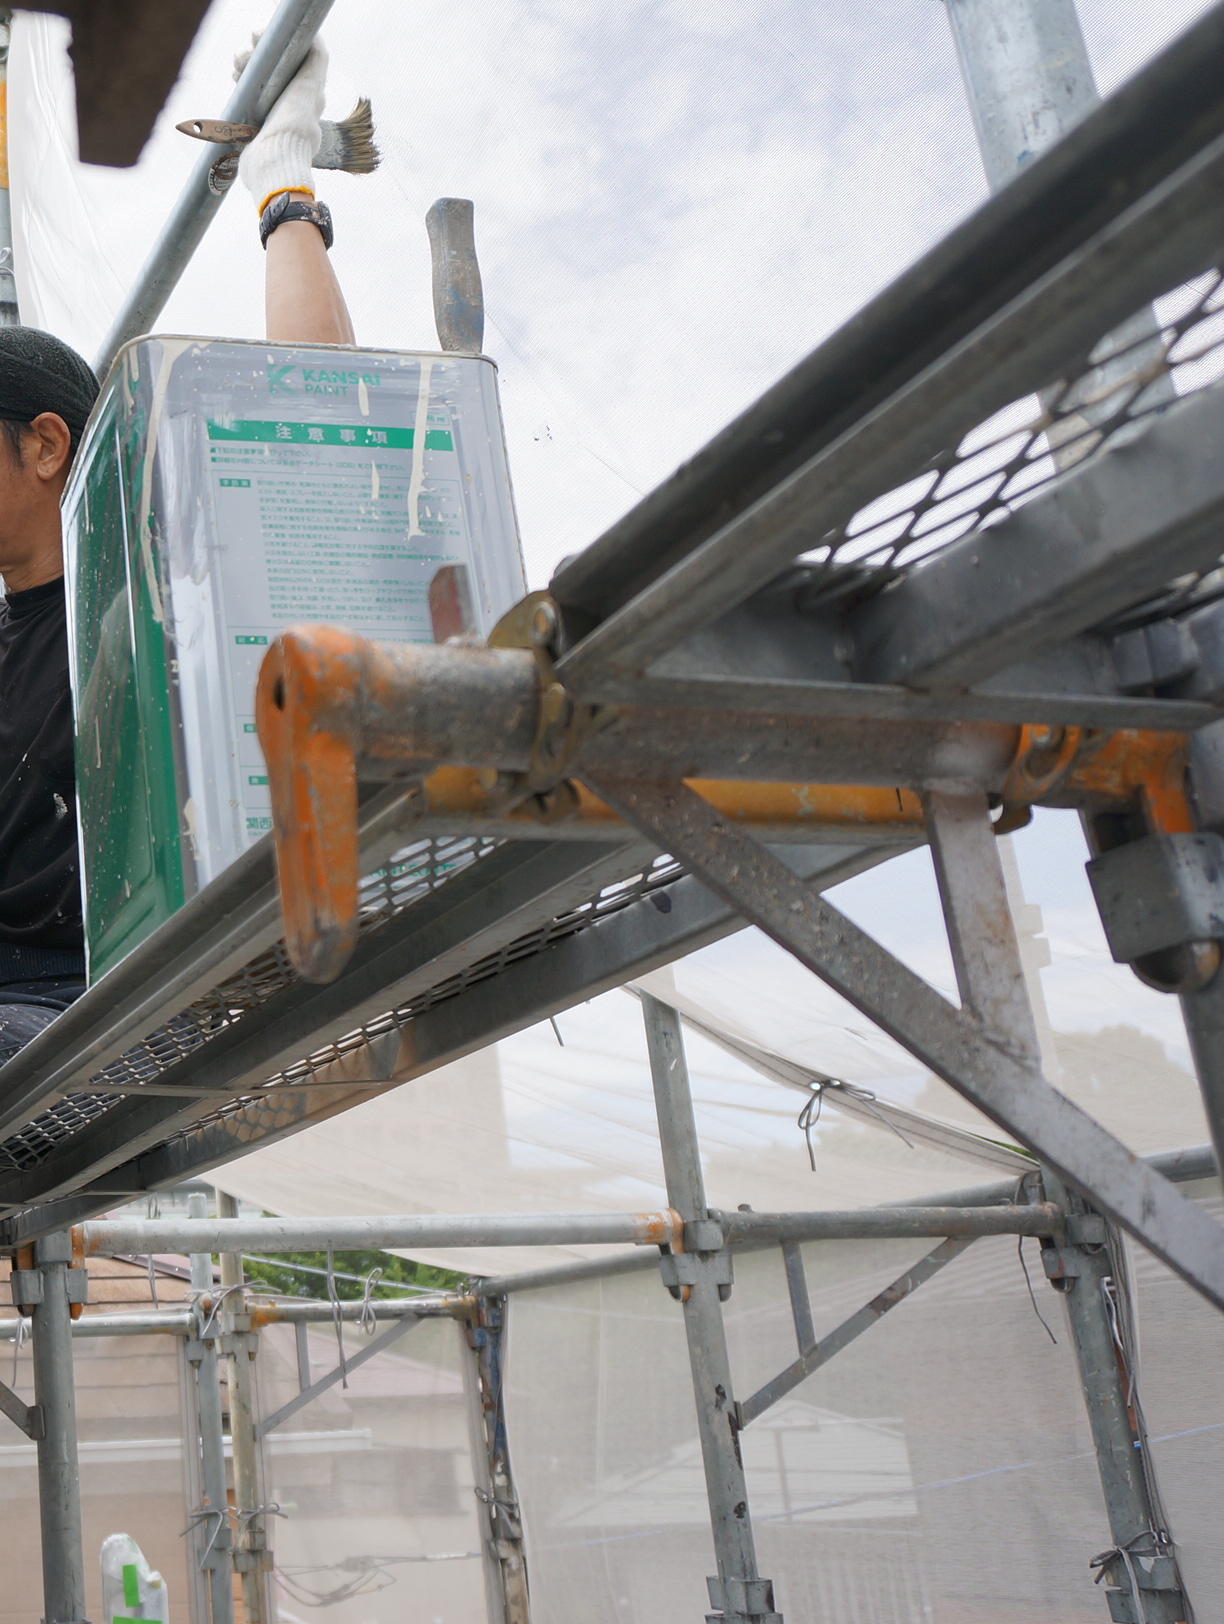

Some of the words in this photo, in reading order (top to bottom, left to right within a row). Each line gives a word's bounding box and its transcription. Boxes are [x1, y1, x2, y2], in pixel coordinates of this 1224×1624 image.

[302, 368, 381, 386] KANSAI
[304, 384, 349, 397] PAINT
[275, 425, 388, 444] 注意事項
